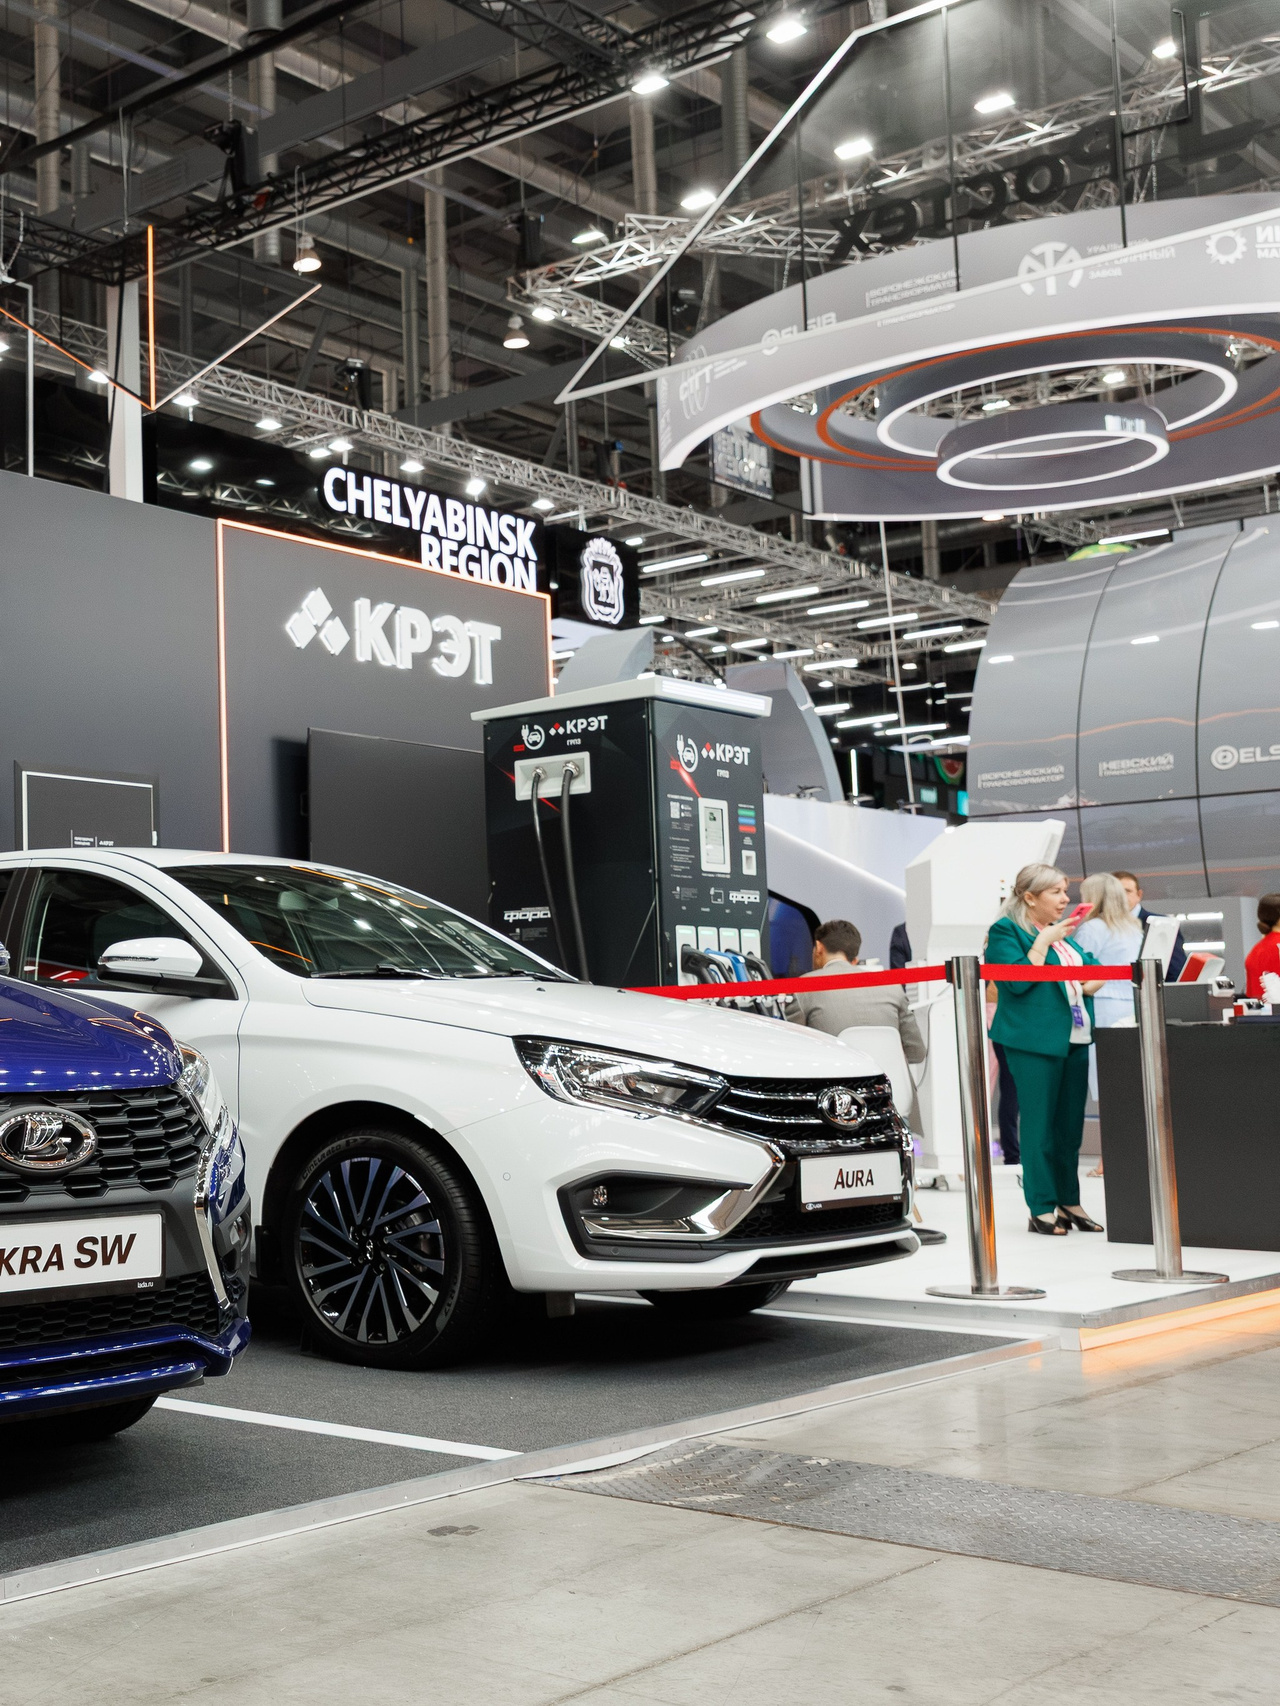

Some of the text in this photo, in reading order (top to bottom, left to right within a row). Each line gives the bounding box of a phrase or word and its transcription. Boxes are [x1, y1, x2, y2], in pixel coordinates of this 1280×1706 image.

[1257, 248, 1280, 259] МА
[323, 467, 538, 561] CHELYABINSK
[421, 533, 538, 593] REGION
[354, 597, 502, 685] КРЭТ
[566, 715, 608, 734] КРЭТ
[715, 743, 751, 766] КРЭТ
[74, 1233, 137, 1269] SW
[137, 1280, 154, 1289] lada.ru
